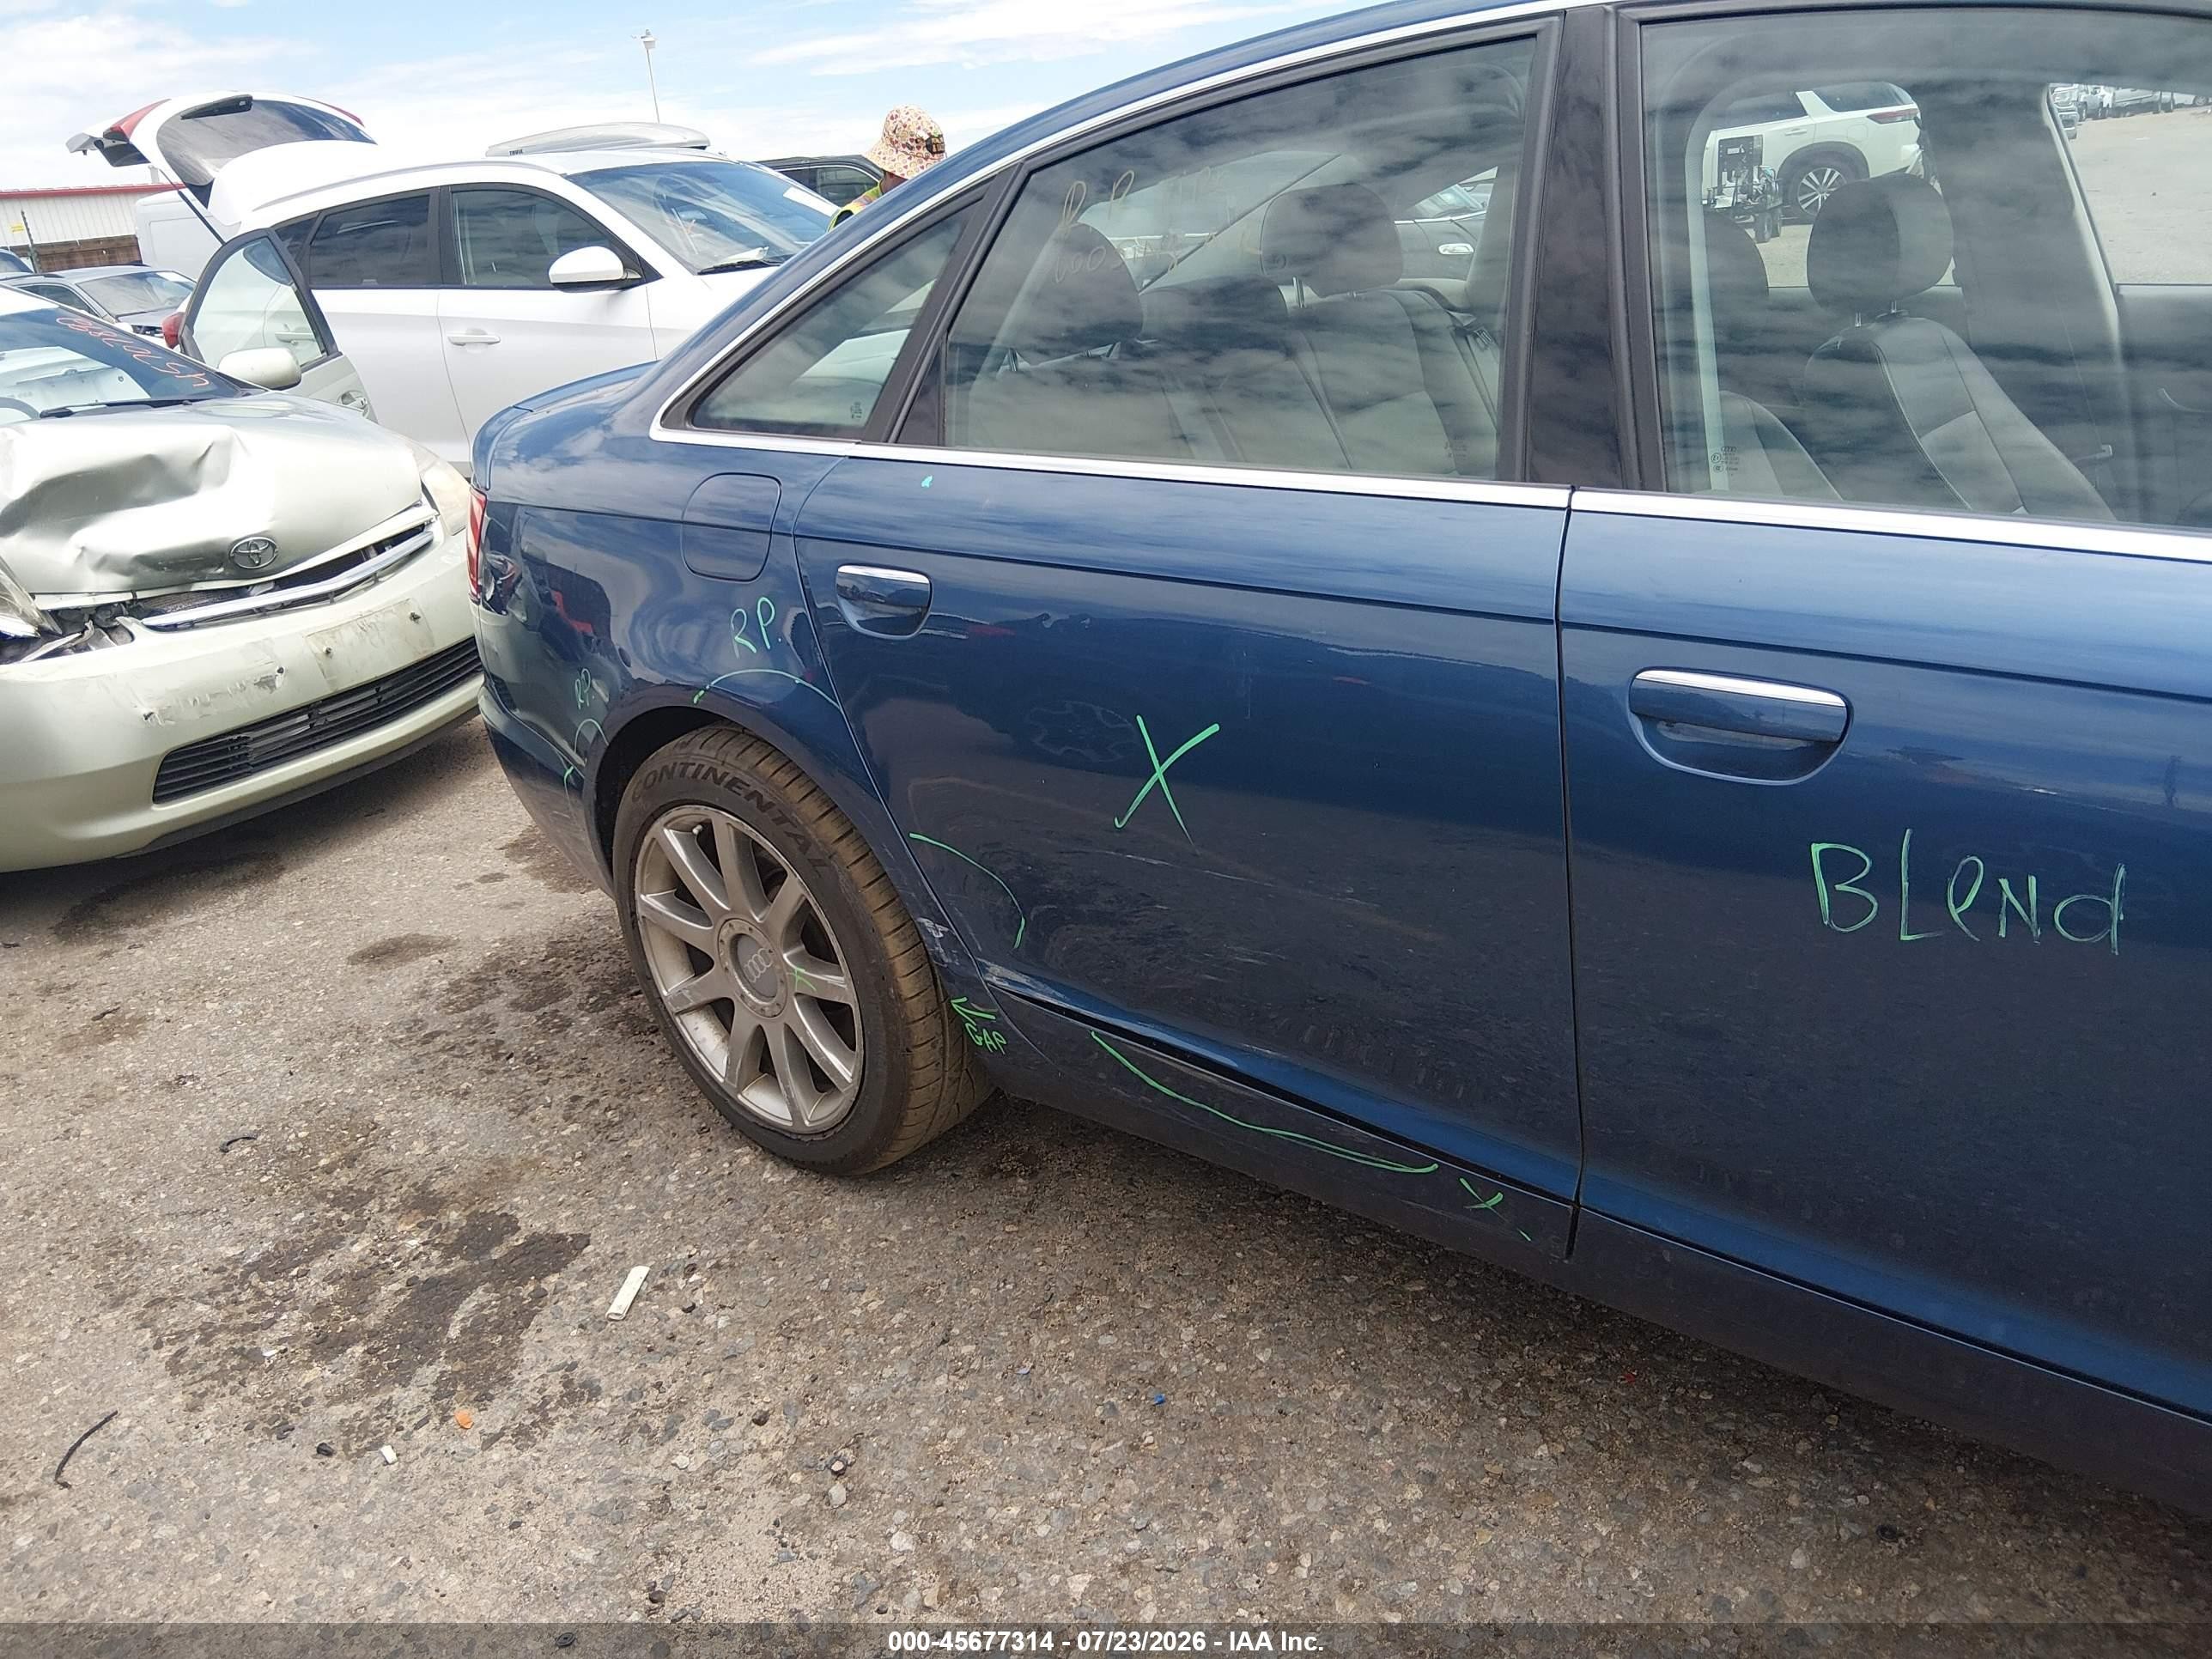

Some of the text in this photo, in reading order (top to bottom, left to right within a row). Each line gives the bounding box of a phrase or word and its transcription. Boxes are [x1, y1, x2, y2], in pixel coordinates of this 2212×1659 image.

[632, 761, 833, 878] CONTINENTAL
[1114, 715, 1219, 848] X
[964, 1023, 1007, 1054] GAP
